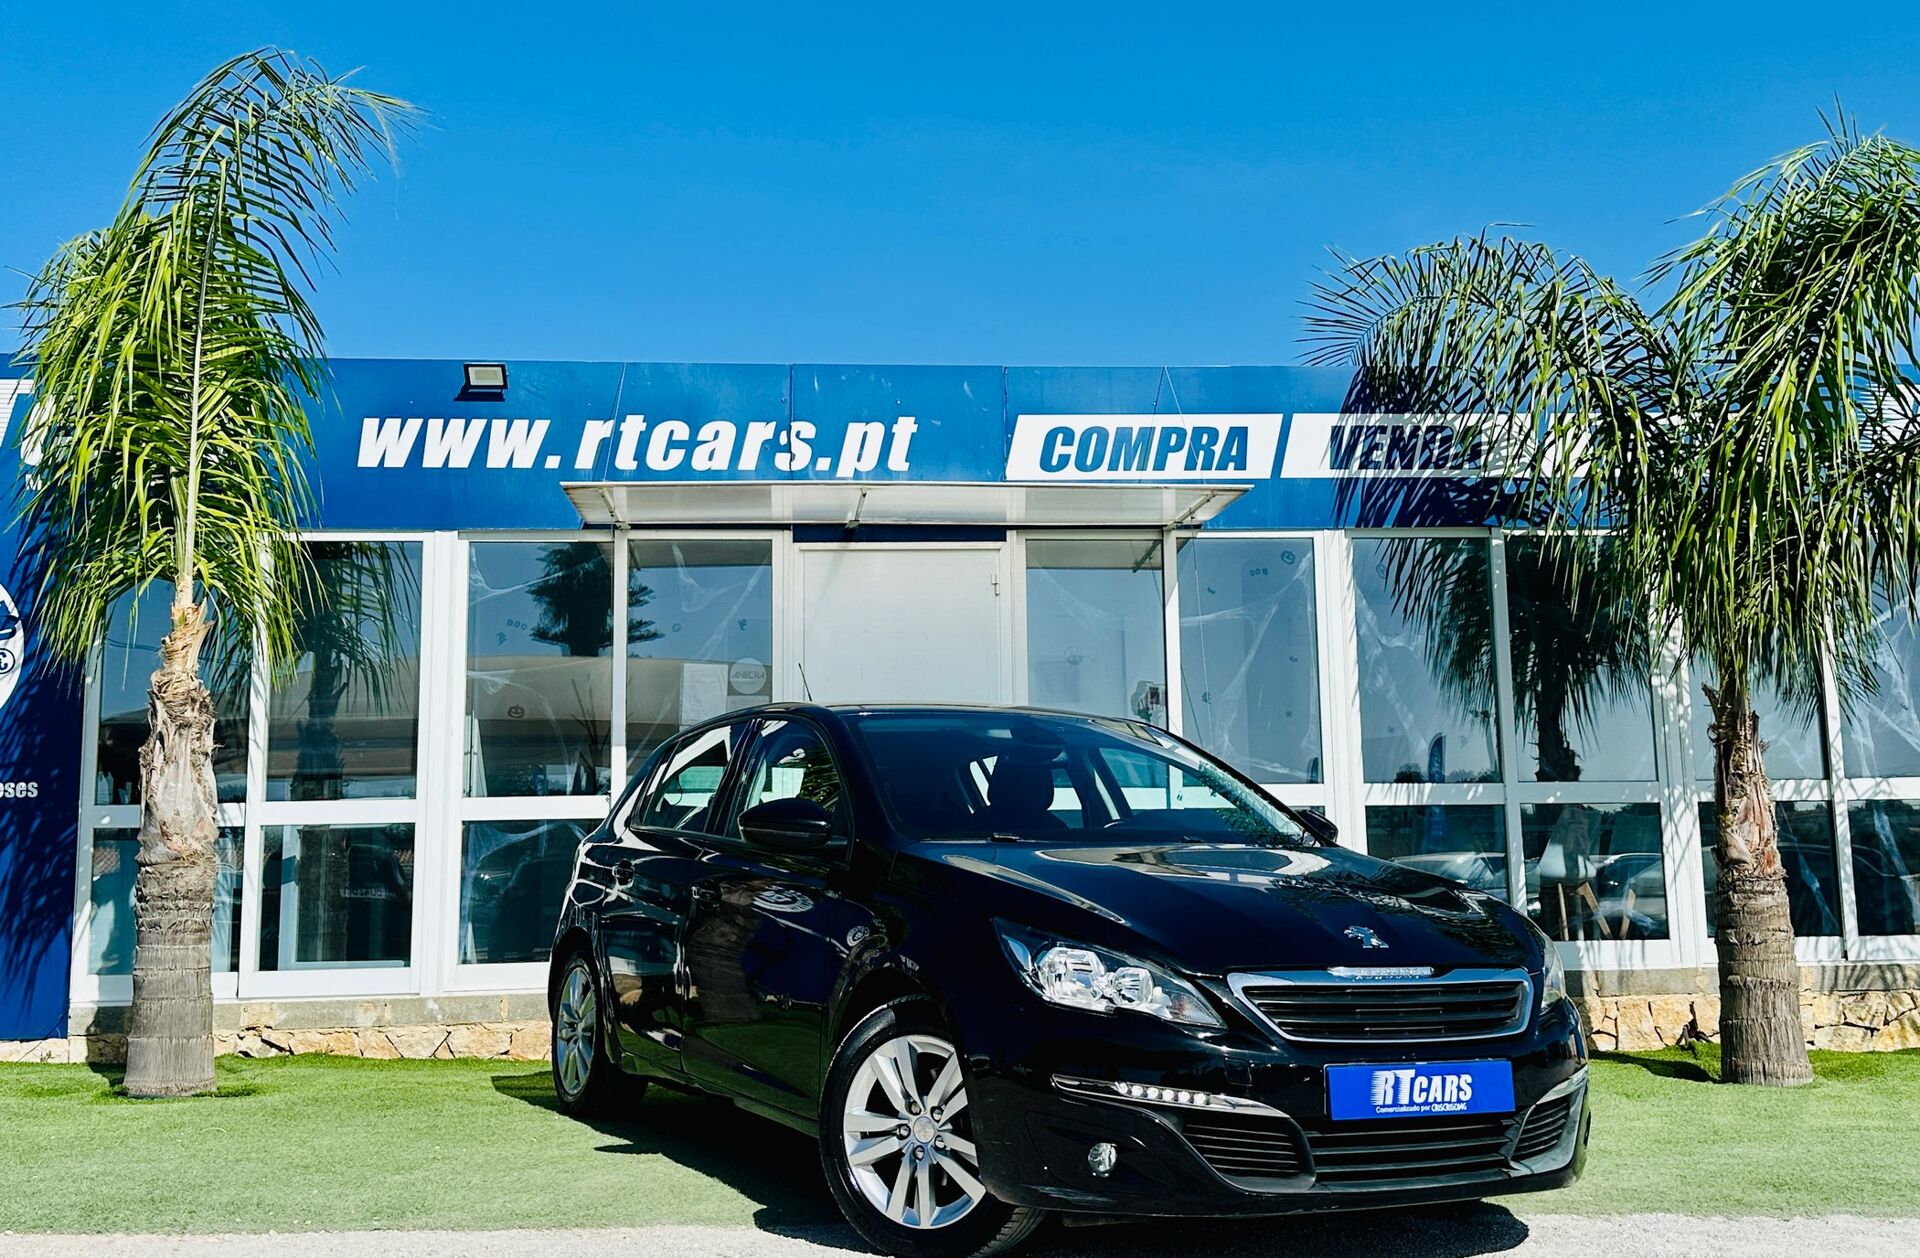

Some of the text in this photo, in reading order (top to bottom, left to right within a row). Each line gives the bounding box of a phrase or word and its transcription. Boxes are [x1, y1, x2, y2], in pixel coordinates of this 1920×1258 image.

[357, 414, 918, 477] www.rtcars.pt
[1038, 425, 1250, 473] COMPRA
[1420, 1104, 1430, 1113] por
